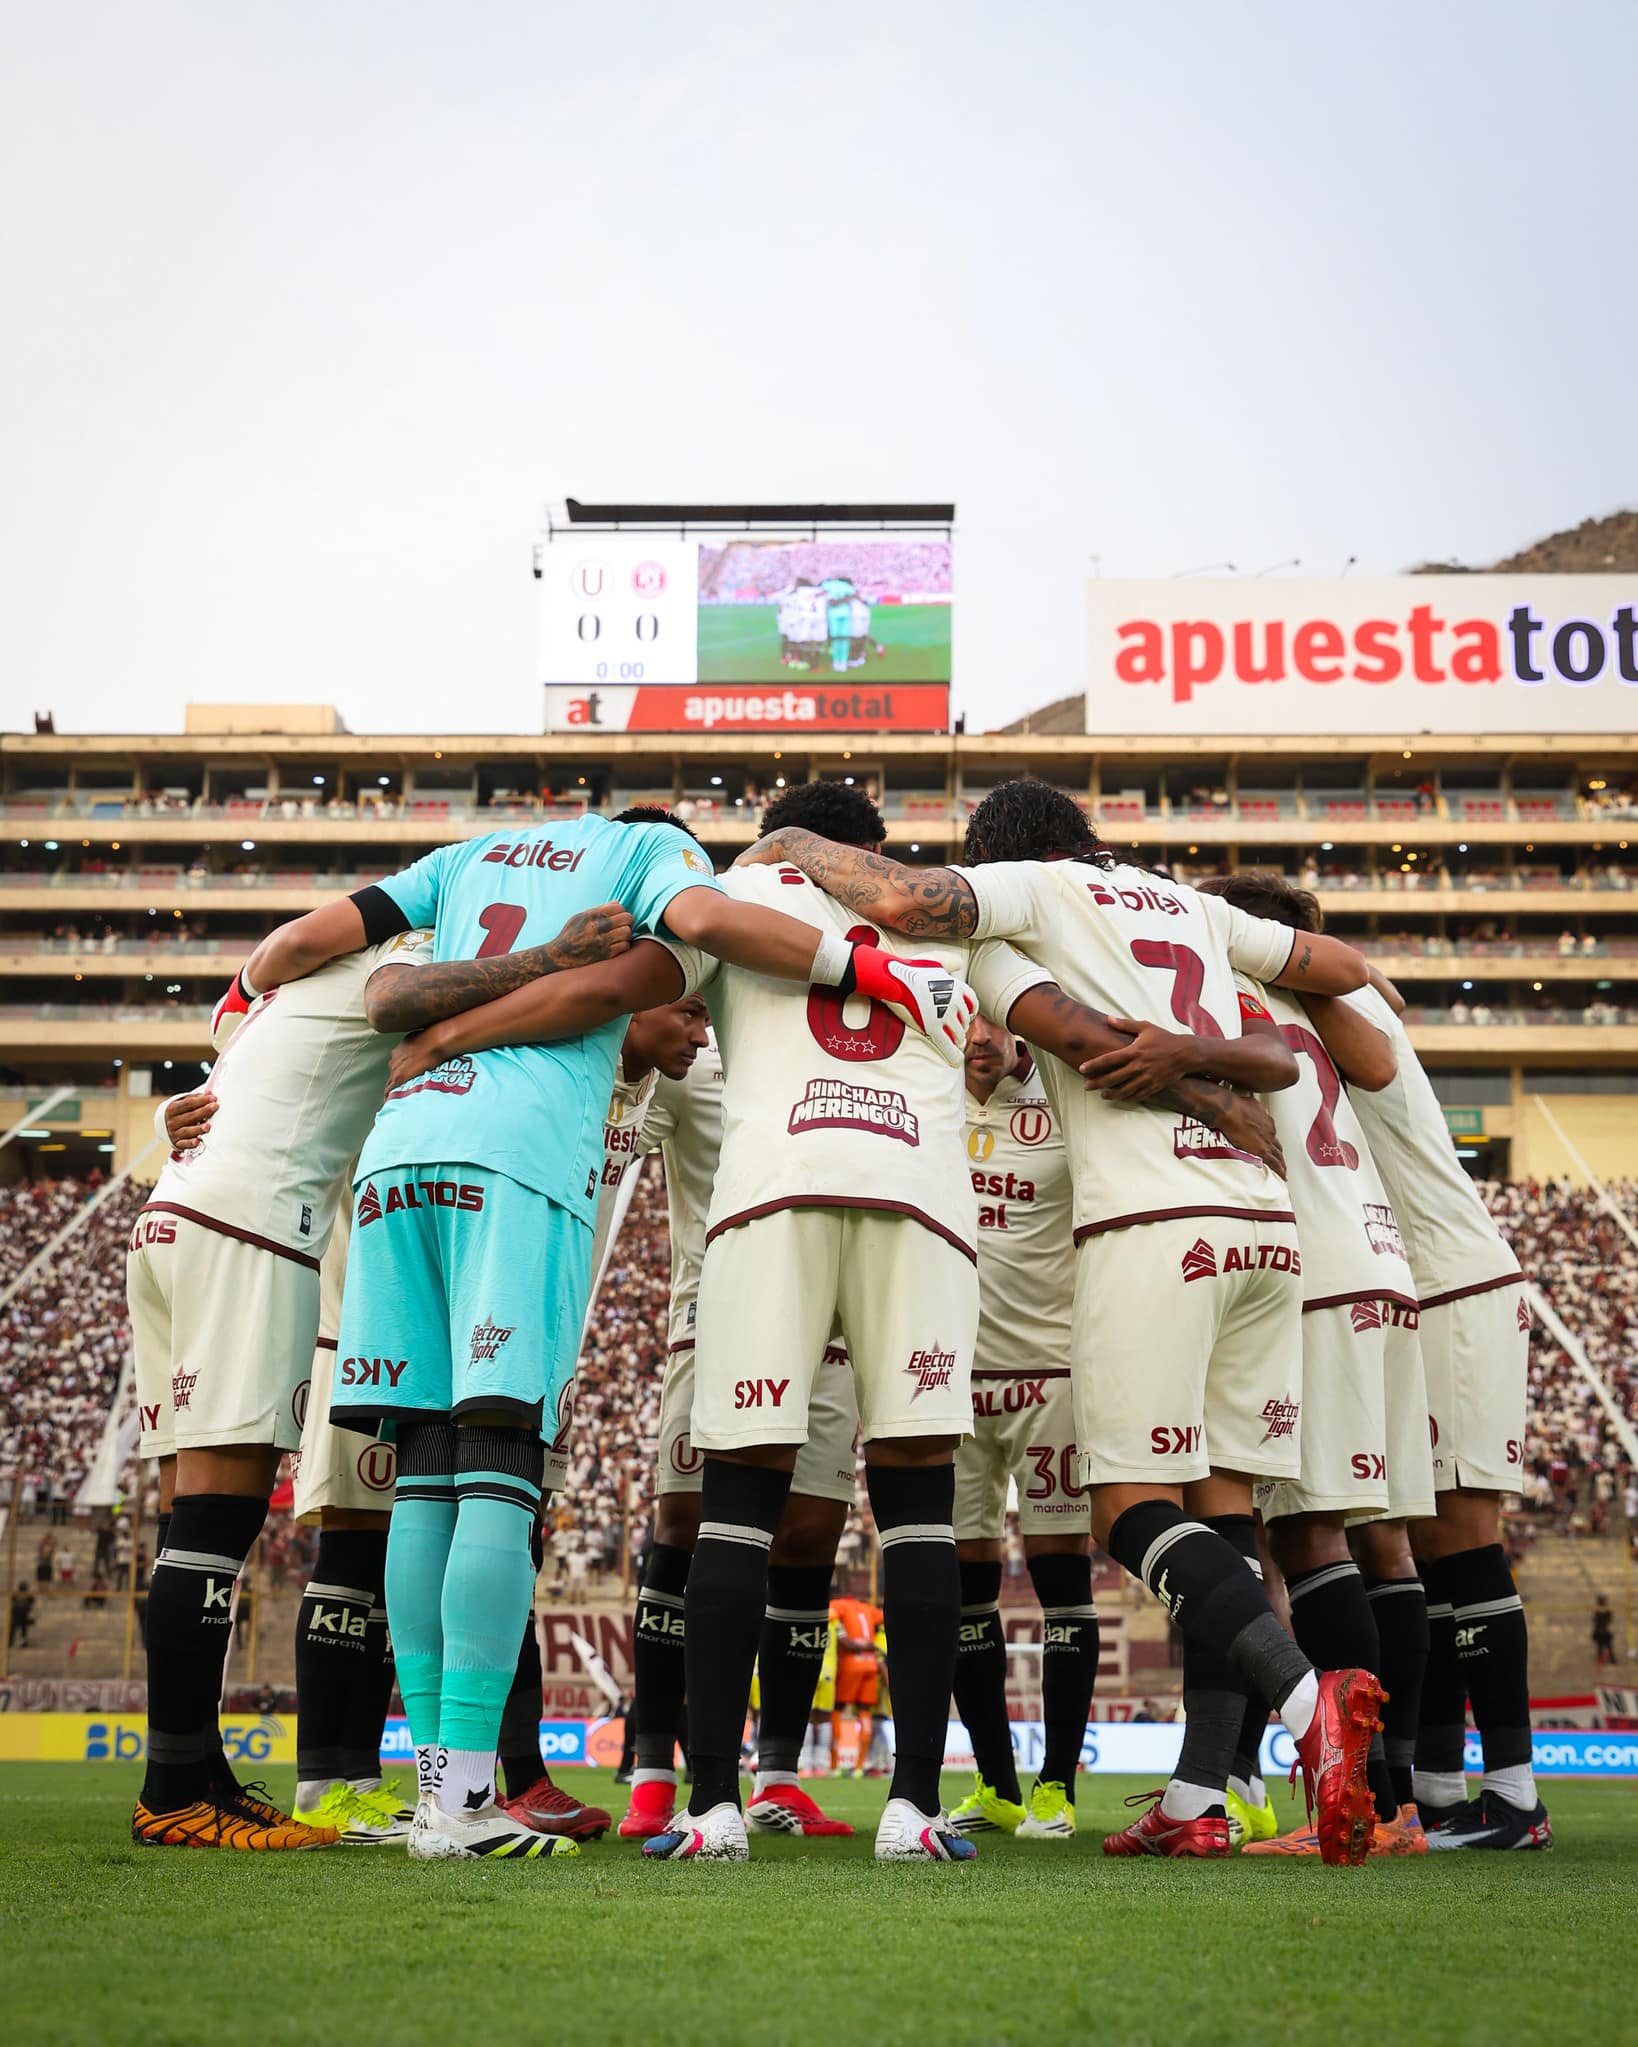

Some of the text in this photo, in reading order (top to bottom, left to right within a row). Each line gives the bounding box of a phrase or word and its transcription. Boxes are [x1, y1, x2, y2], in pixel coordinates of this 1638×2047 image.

[577, 613, 659, 641] 0 0
[567, 691, 602, 726] at
[504, 839, 587, 872] bitel
[1112, 886, 1189, 916] bitel
[475, 902, 528, 960] 1
[1130, 938, 1225, 1039] 7
[808, 1079, 904, 1110] HINCHADA
[791, 1097, 918, 1139] MERENGUE
[1019, 1112, 1043, 1141] U
[386, 1180, 485, 1214] ALTOS
[1222, 1244, 1302, 1276] ALTOS
[471, 1324, 512, 1343] Electro
[471, 1341, 500, 1364] light
[908, 1350, 955, 1369] Electro
[341, 1357, 409, 1387] SKY
[918, 1367, 952, 1391] light
[734, 1378, 790, 1410] SKY
[1151, 1423, 1202, 1454] SKY
[1267, 1416, 1295, 1438] light
[367, 1451, 393, 1485] U
[1033, 1502, 1089, 1514] marathon
[223, 1727, 273, 1760] 5G
